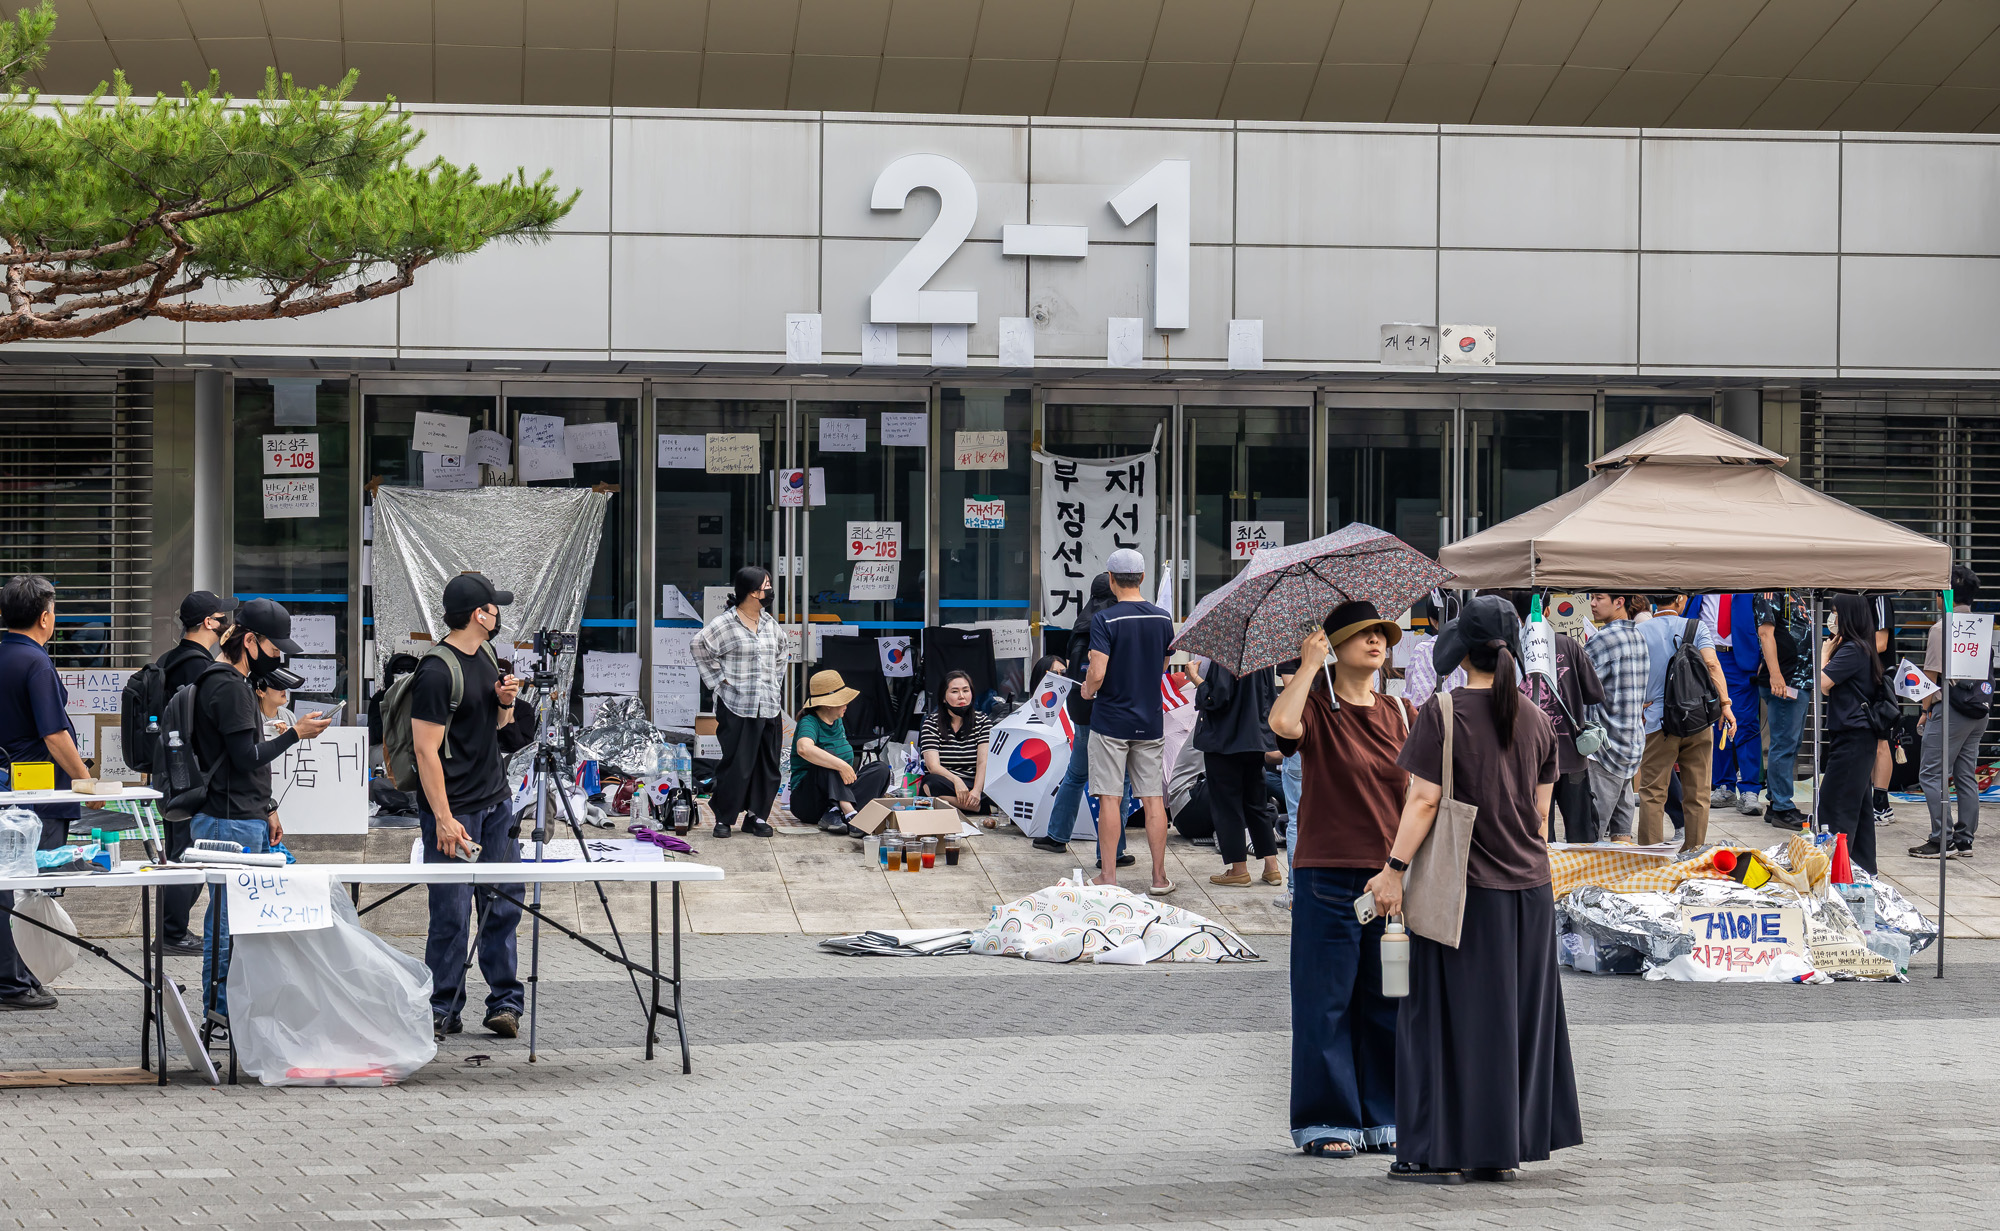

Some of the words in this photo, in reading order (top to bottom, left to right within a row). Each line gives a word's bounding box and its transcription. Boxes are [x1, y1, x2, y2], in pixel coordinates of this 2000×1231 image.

[870, 152, 1190, 329] 2-1
[1384, 334, 1431, 350] 재선거
[266, 439, 287, 452] 최소
[288, 438, 309, 452] 상주
[273, 451, 315, 469] 9-10명
[265, 483, 290, 495] 반드시
[293, 483, 315, 493] 자리를
[967, 502, 1004, 521] 재선거
[1100, 461, 1145, 549] 재선
[851, 527, 873, 540] 최소
[875, 526, 896, 540] 상주
[1050, 460, 1086, 617] 부정선거
[1236, 525, 1266, 541] 최소
[851, 540, 897, 558] 9~10명
[1235, 539, 1259, 556] 9명
[855, 565, 873, 575] 반드시
[1952, 620, 1976, 639] 상주
[1953, 642, 1979, 657] 10명
[87, 672, 124, 692] 스스로
[92, 695, 118, 711] 왔음
[238, 872, 289, 900] 일반
[257, 903, 325, 928] 쓰레기
[1690, 911, 1788, 944] 게이트
[1692, 945, 1800, 973] 지켜주세
[1840, 949, 1848, 957] 저
[1849, 948, 1865, 957] 소나무
